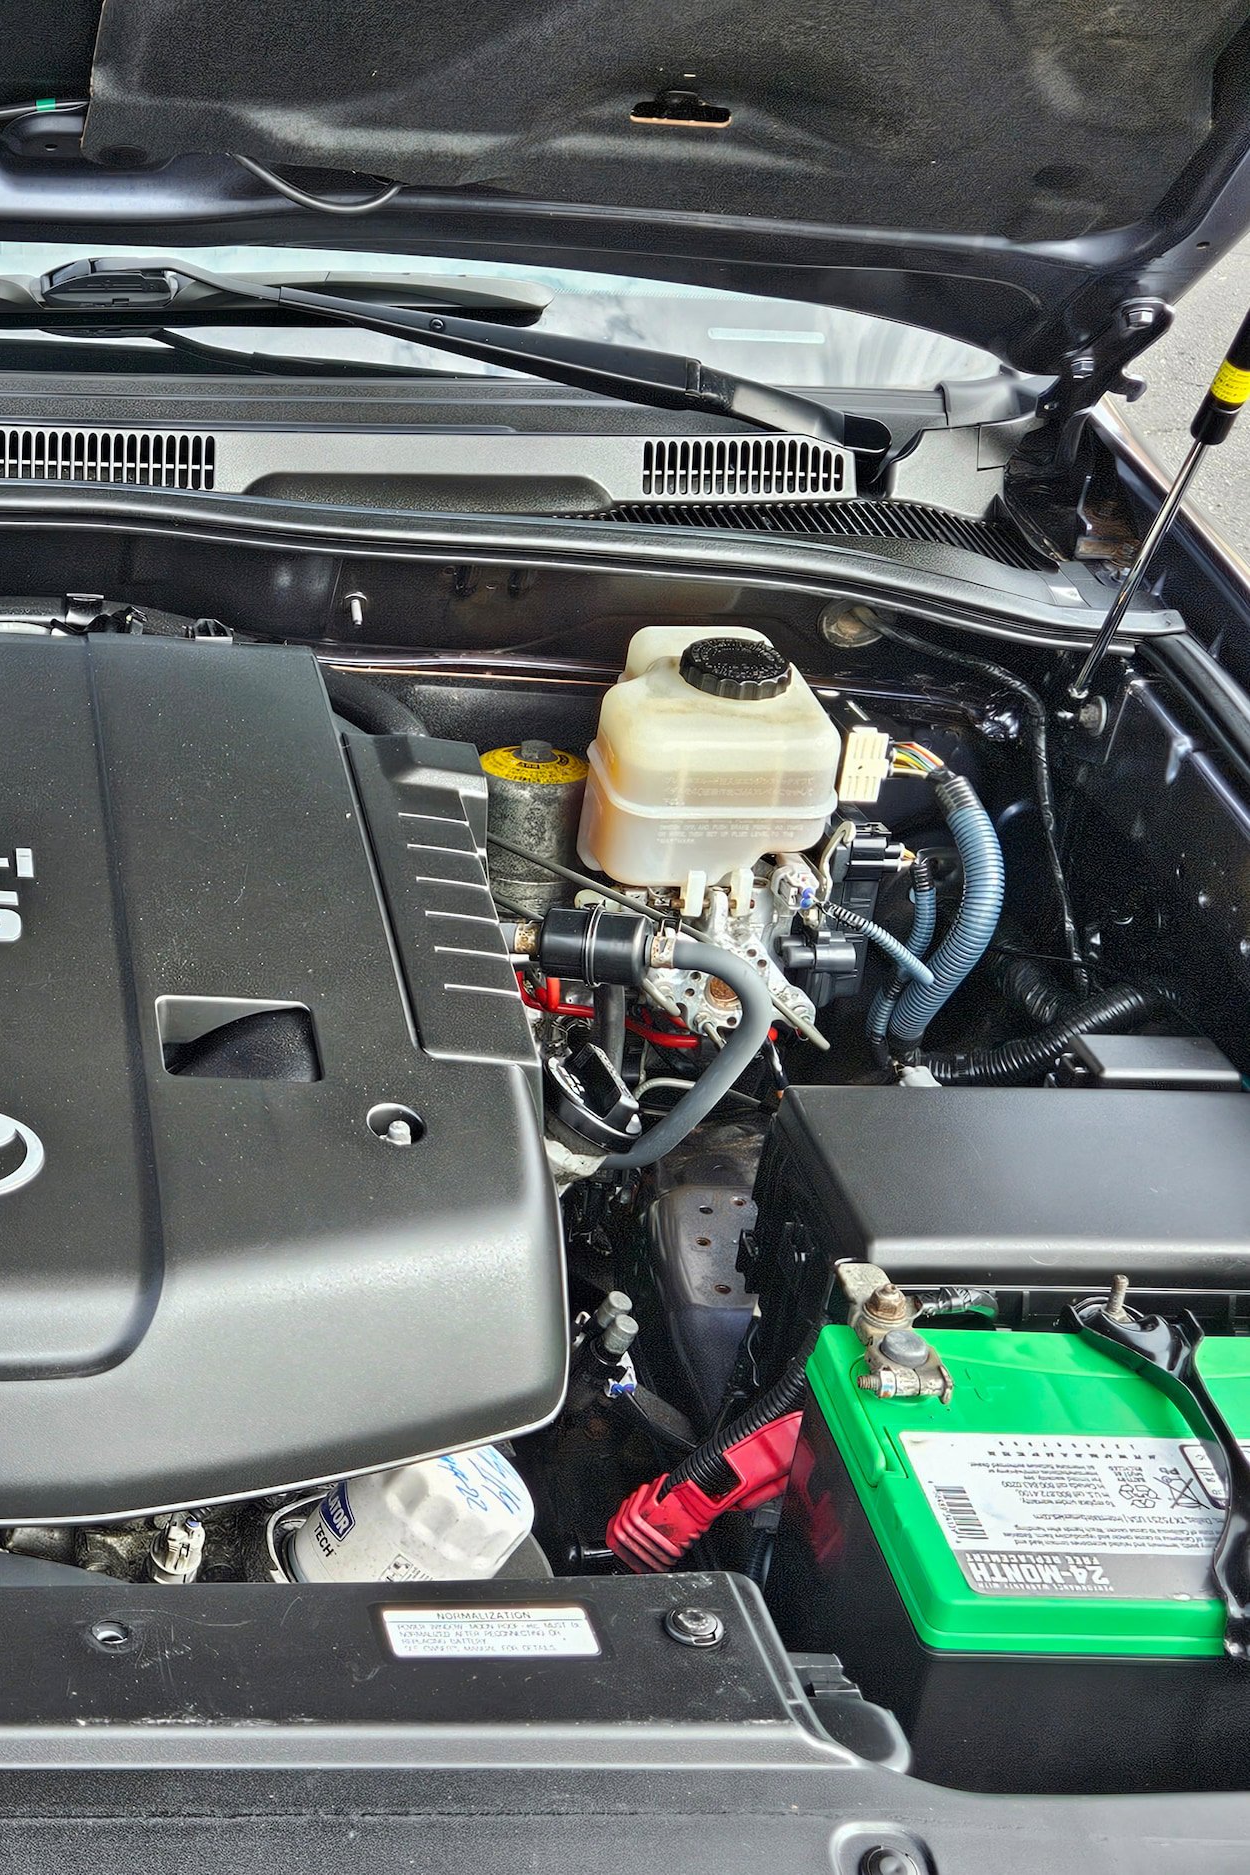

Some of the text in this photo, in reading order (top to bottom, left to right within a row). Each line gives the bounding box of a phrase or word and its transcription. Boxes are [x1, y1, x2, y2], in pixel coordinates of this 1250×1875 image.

[1158, 1467, 1180, 1475] Pb
[313, 1522, 334, 1557] TECH
[966, 1552, 1100, 1564] FREE REPLACEMENT
[968, 1563, 1110, 1584] 24-MONTH
[436, 1612, 532, 1620] NORMALIZATION
